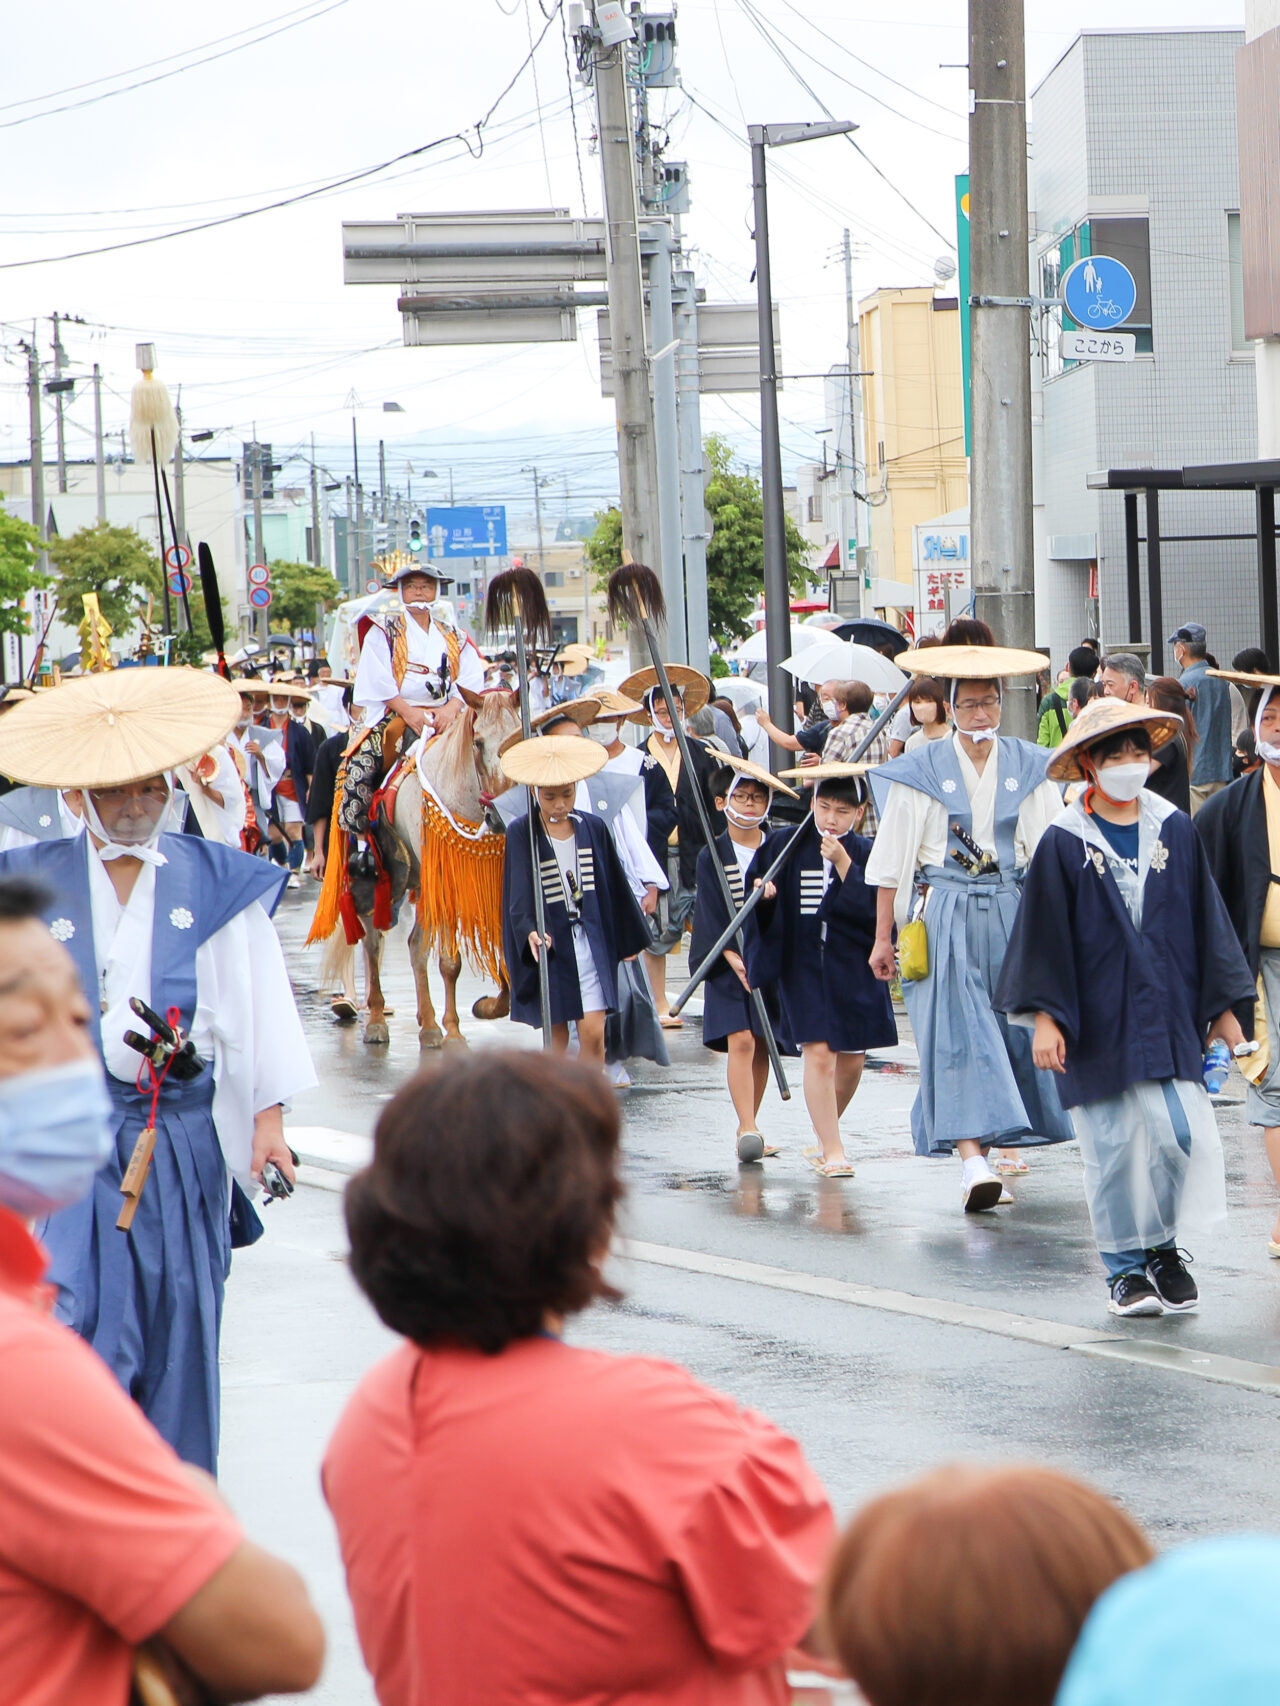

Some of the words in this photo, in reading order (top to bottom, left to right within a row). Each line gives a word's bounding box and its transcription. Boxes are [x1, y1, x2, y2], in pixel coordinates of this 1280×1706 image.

[1075, 339, 1124, 355] ここから
[254, 570, 265, 580] 40
[927, 572, 965, 585] たばこ
